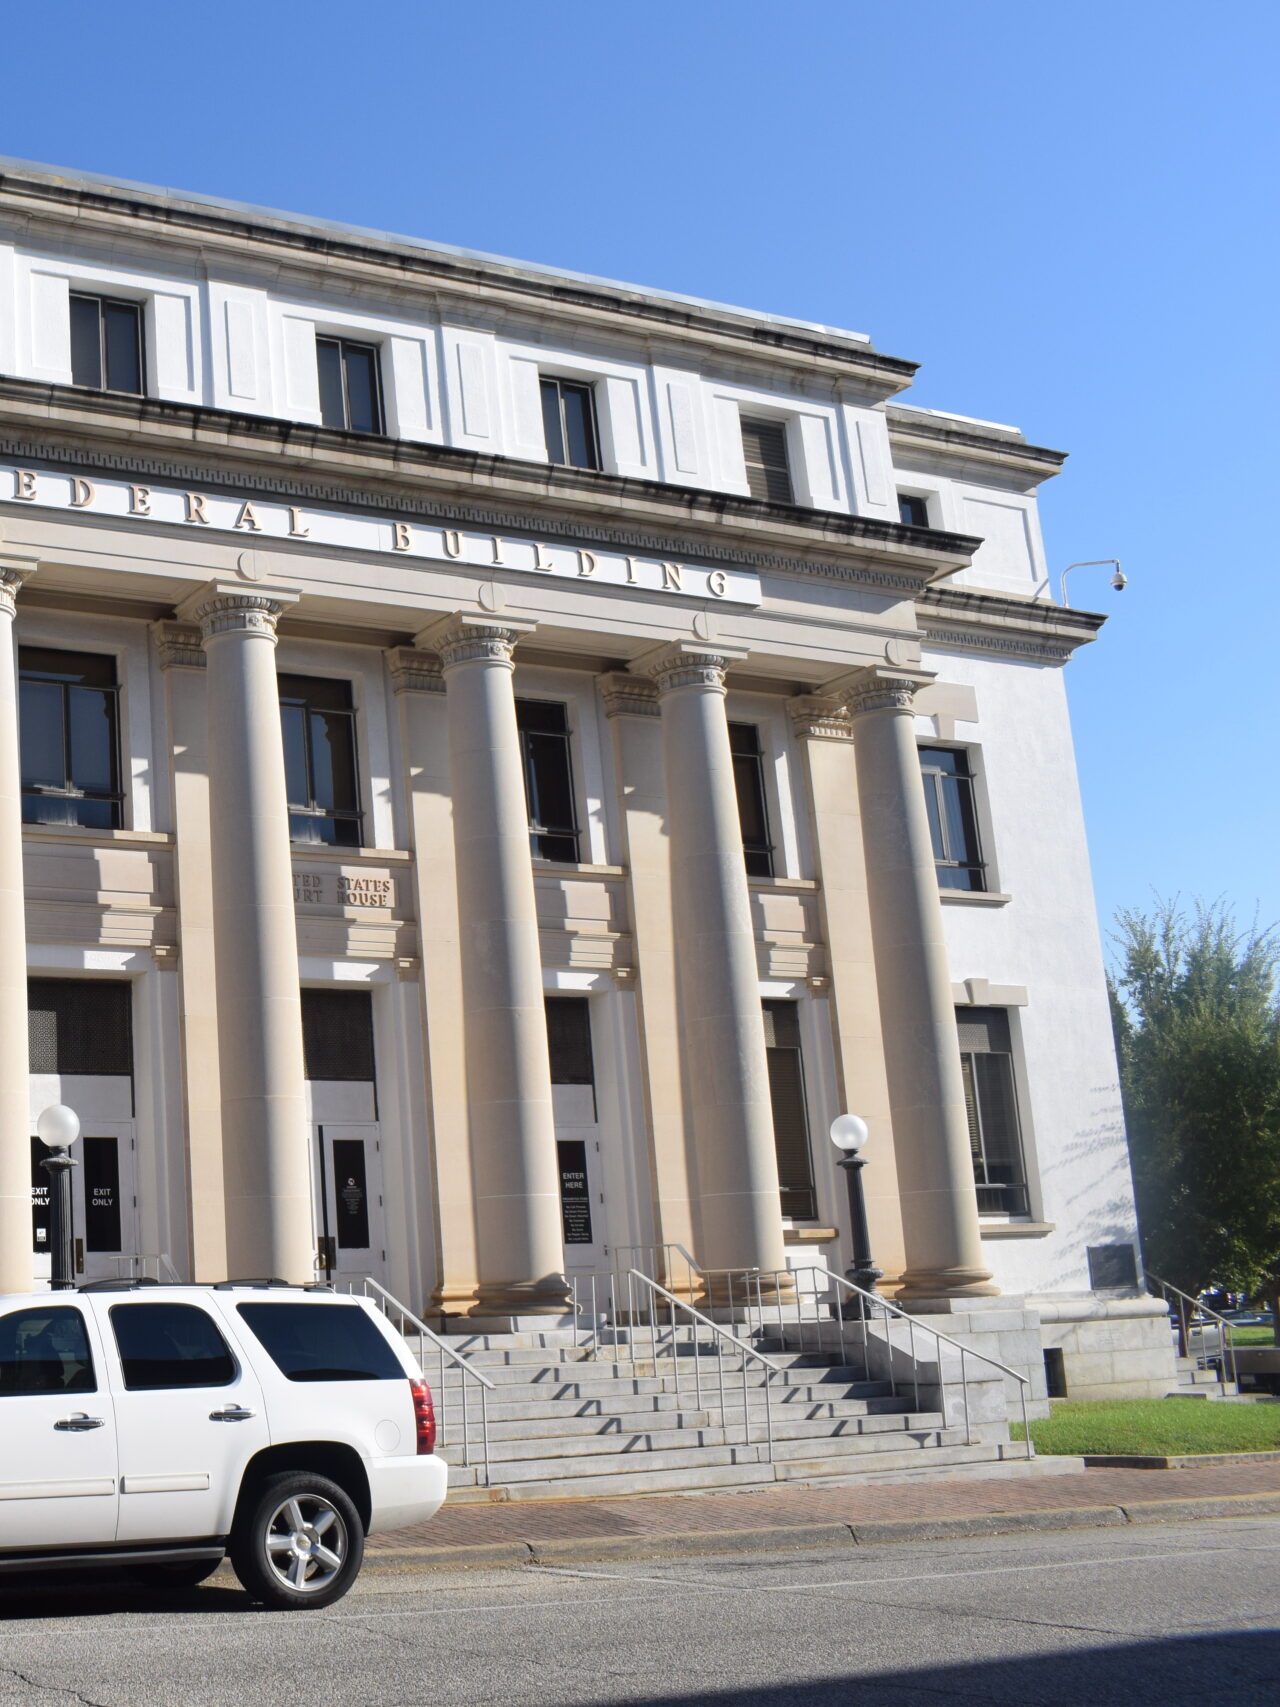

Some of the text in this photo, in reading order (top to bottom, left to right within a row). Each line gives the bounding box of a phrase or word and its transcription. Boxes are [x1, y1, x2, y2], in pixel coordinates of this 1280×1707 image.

[391, 522, 728, 598] BUILDING
[292, 872, 390, 893] TED STATES
[336, 891, 387, 907] HOUSE
[562, 1172, 585, 1180] ENTER
[565, 1181, 584, 1189] HERE
[31, 1187, 48, 1195] EXIT
[93, 1188, 111, 1196] EXIT
[92, 1198, 113, 1206] ONLY
